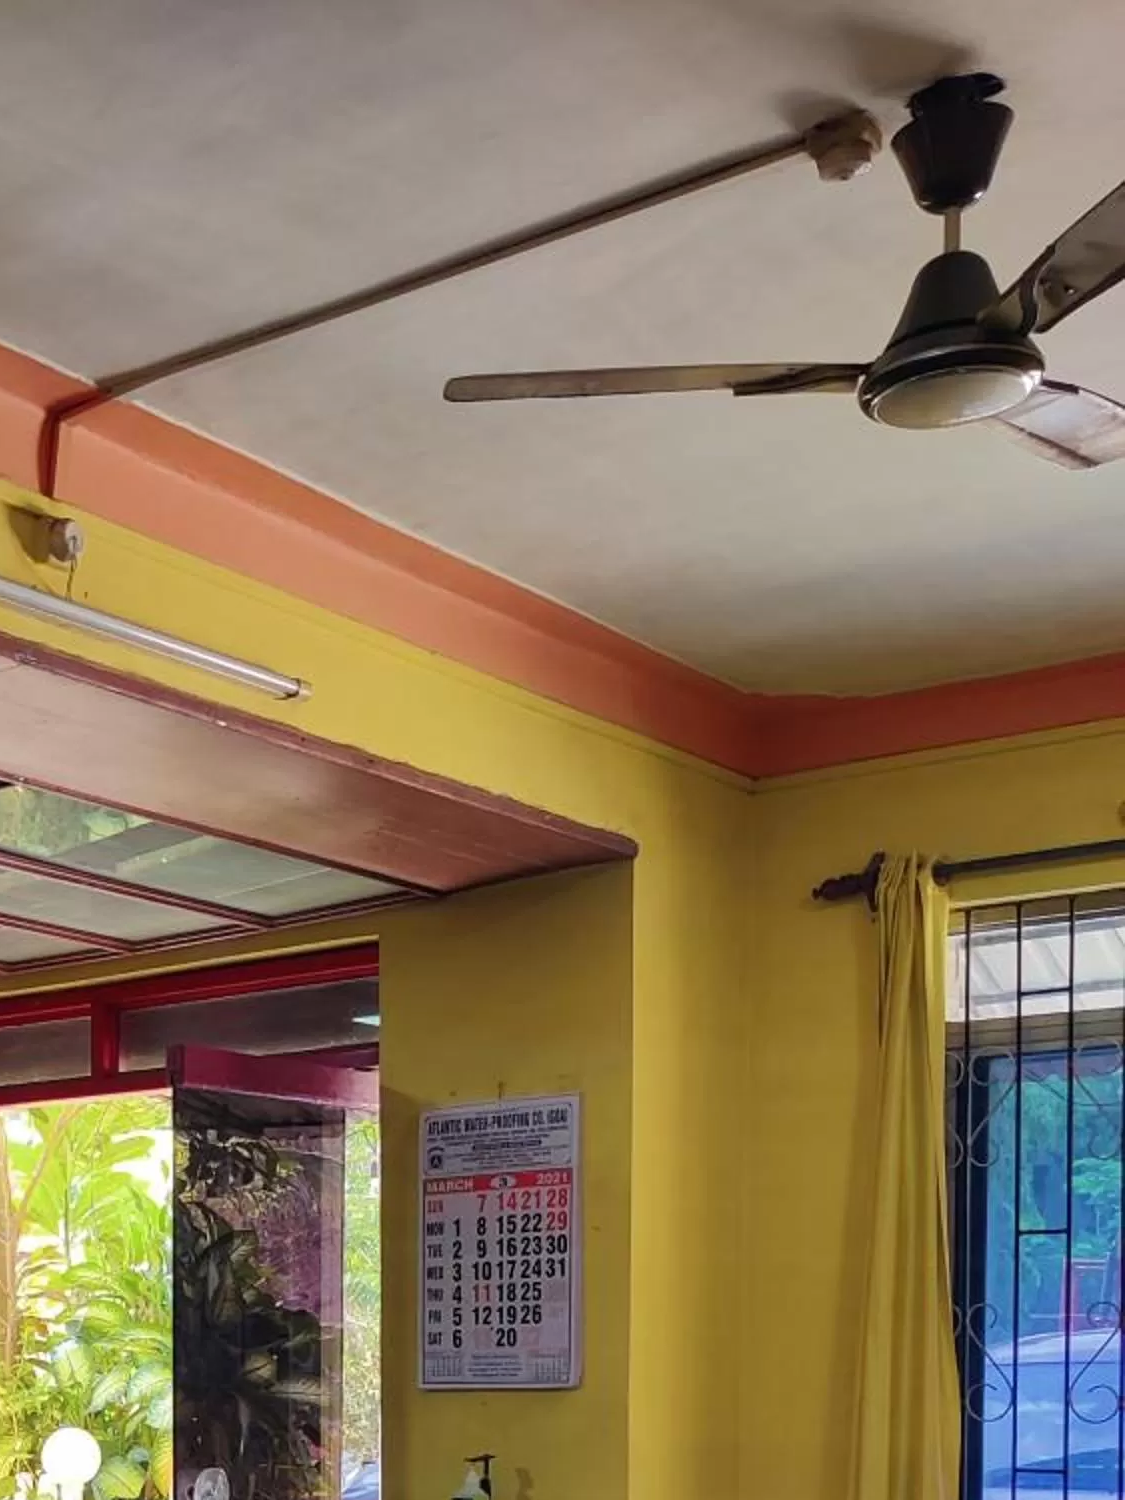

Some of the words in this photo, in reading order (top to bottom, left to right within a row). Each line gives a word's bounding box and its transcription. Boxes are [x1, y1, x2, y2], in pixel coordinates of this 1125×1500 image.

[428, 1120, 461, 1135] ATLANTIC
[427, 1179, 473, 1192] MARCH
[535, 1172, 568, 1185] 2021
[477, 1194, 487, 1212] 7
[497, 1192, 517, 1211] 14
[521, 1190, 541, 1209] 21
[547, 1188, 567, 1208] 28
[453, 1218, 460, 1236] 1
[477, 1217, 486, 1236] 8
[496, 1215, 517, 1234] 15
[521, 1213, 542, 1232] 22
[547, 1212, 567, 1230] 29
[427, 1244, 443, 1258] TUE
[453, 1241, 462, 1259] 2
[477, 1239, 487, 1258] 9
[496, 1237, 517, 1257] 16
[521, 1236, 542, 1256] 23
[546, 1235, 567, 1254] 30
[453, 1262, 462, 1282] 3
[472, 1262, 491, 1280] 10
[496, 1261, 517, 1280] 17
[521, 1259, 541, 1278] 24
[546, 1258, 565, 1278] 31
[453, 1286, 462, 1304] 4
[473, 1284, 490, 1302] 11
[497, 1284, 517, 1302] 18
[521, 1282, 542, 1301] 25
[453, 1308, 462, 1326] 5
[472, 1306, 492, 1325] 12
[496, 1305, 517, 1324] 19
[521, 1304, 542, 1324] 26
[428, 1332, 442, 1345] SAT
[453, 1329, 462, 1348] 6
[496, 1328, 517, 1347] 20
